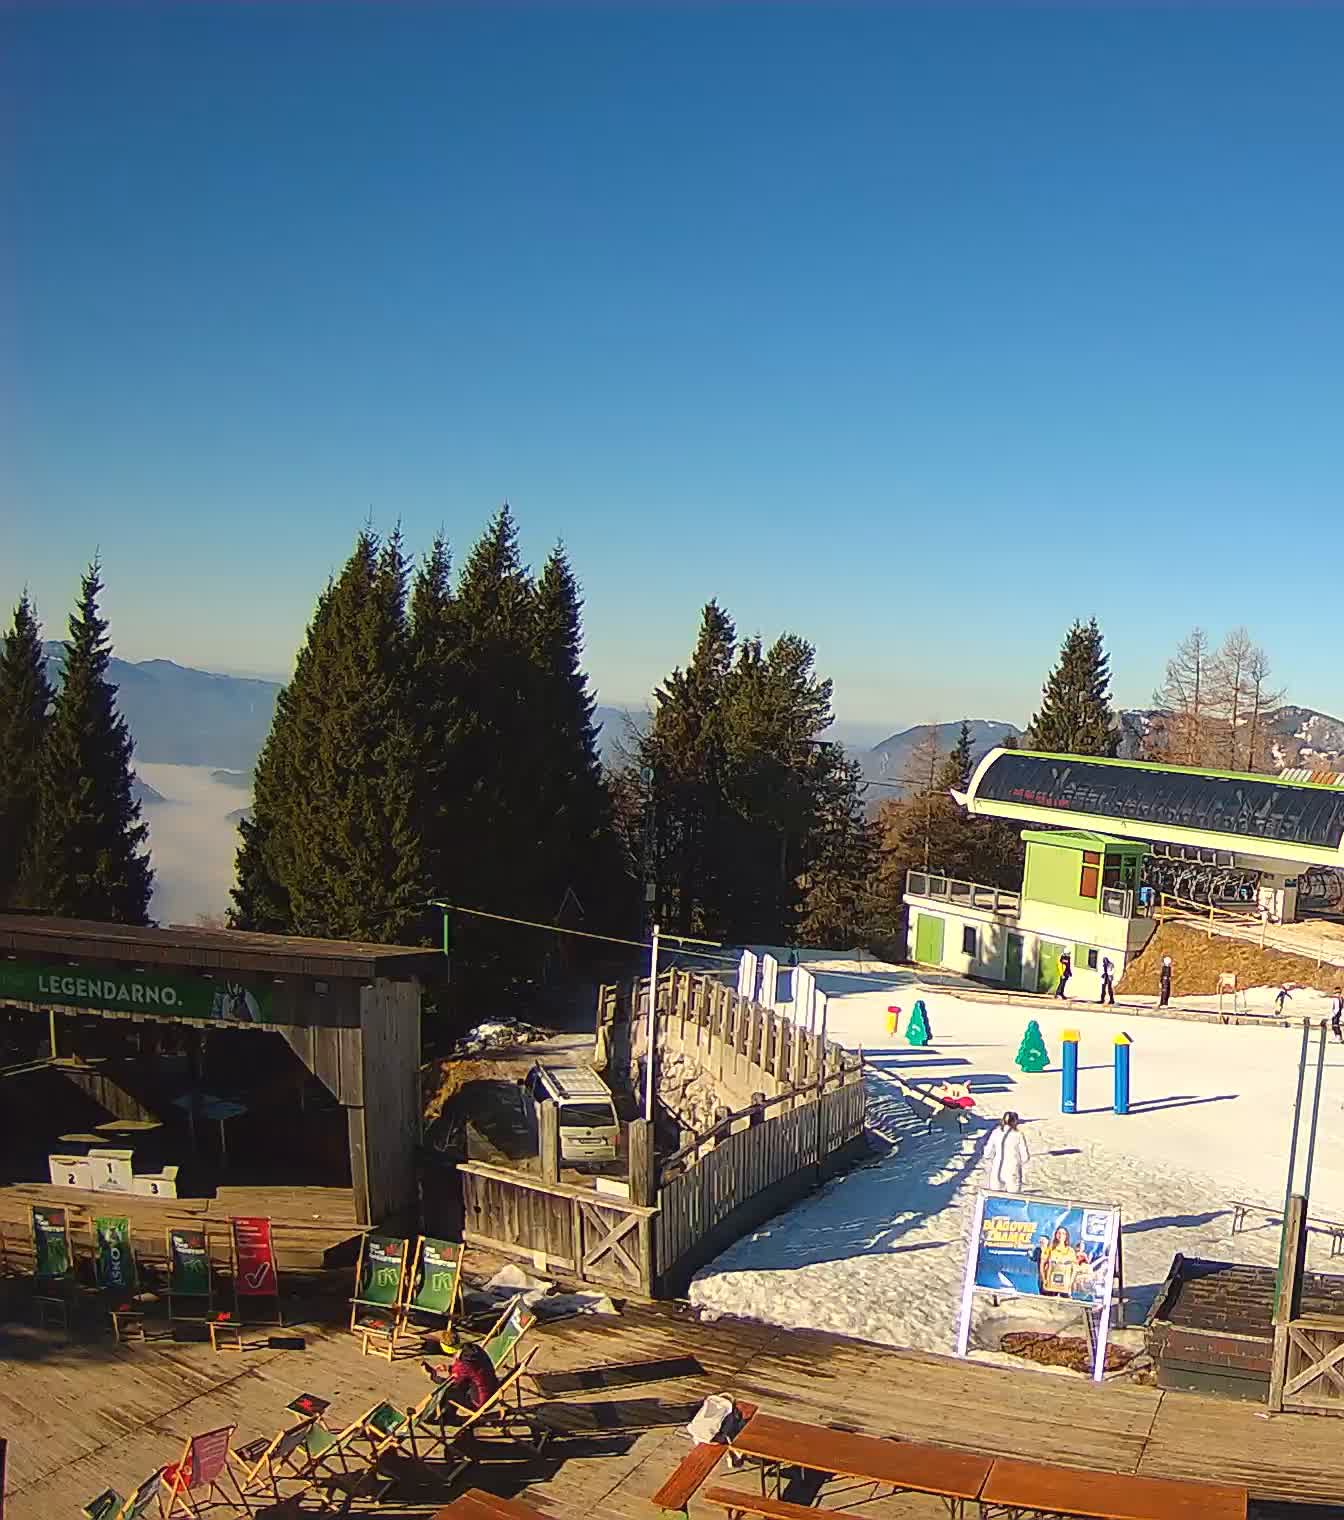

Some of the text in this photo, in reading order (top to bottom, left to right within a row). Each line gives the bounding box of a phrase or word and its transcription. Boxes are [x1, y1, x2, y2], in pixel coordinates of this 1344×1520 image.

[38, 974, 183, 1008] LEGENDARNO.
[104, 1162, 113, 1174] 1
[68, 1173, 77, 1185] 2
[151, 1183, 160, 1195] 3
